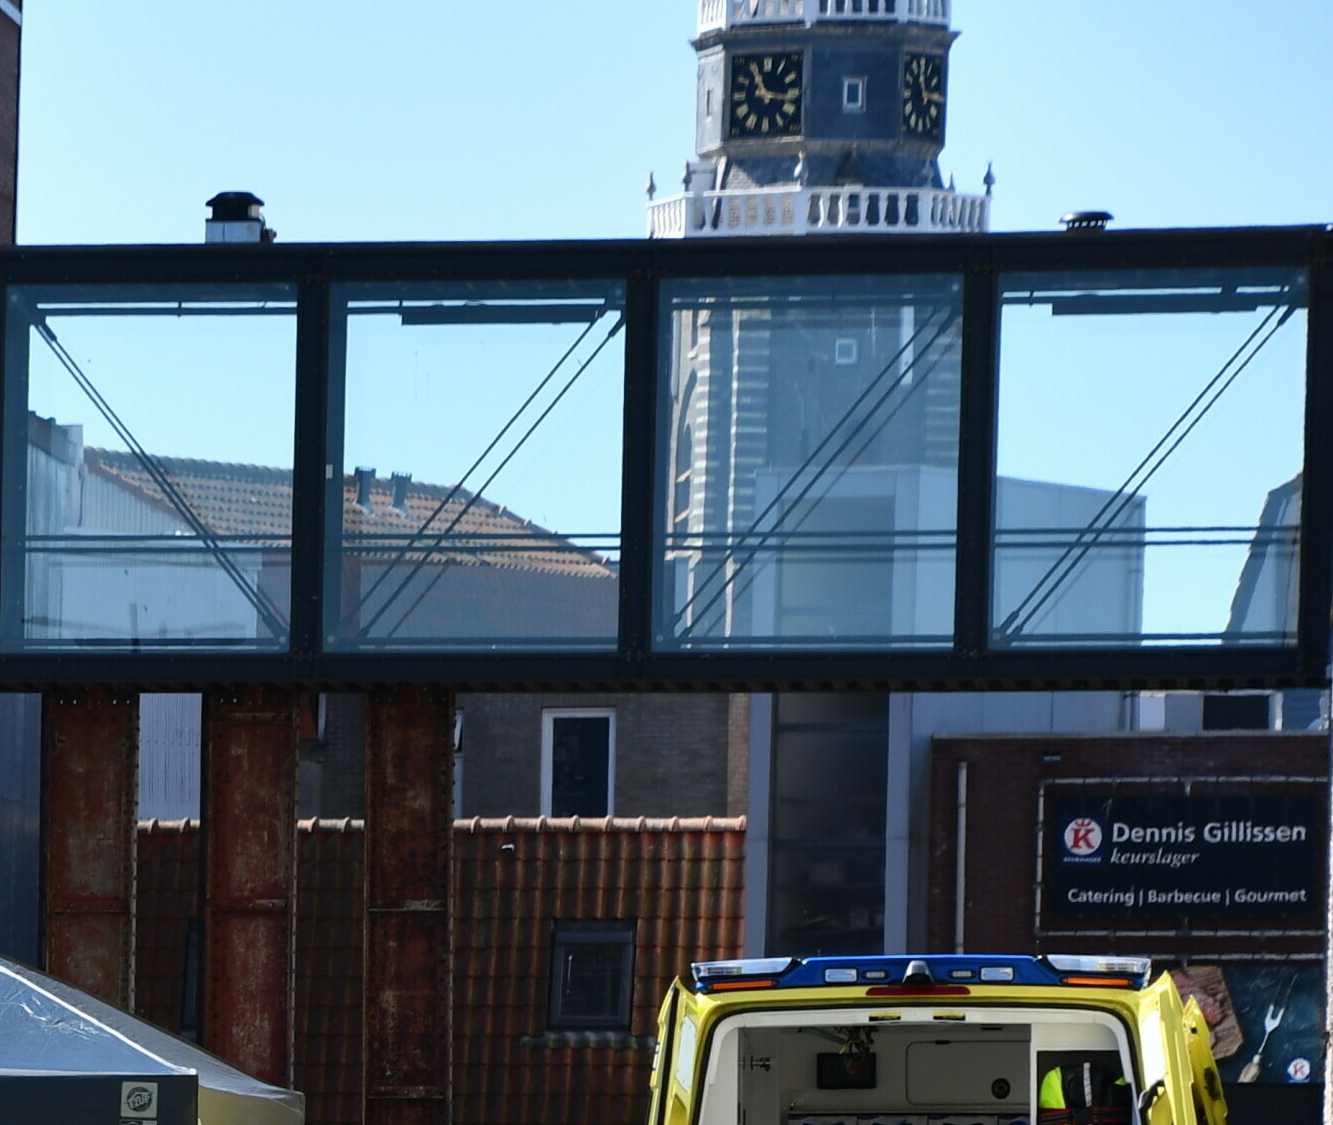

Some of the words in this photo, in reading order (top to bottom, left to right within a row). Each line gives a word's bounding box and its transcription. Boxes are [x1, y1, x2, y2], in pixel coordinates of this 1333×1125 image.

[1111, 821, 1195, 844] Dennis
[1203, 820, 1307, 844] Gillissen
[1109, 847, 1201, 868] keurslager
[1067, 887, 1135, 907] Catering
[1148, 888, 1221, 904] Barbecue
[1234, 888, 1307, 904] Gourmet
